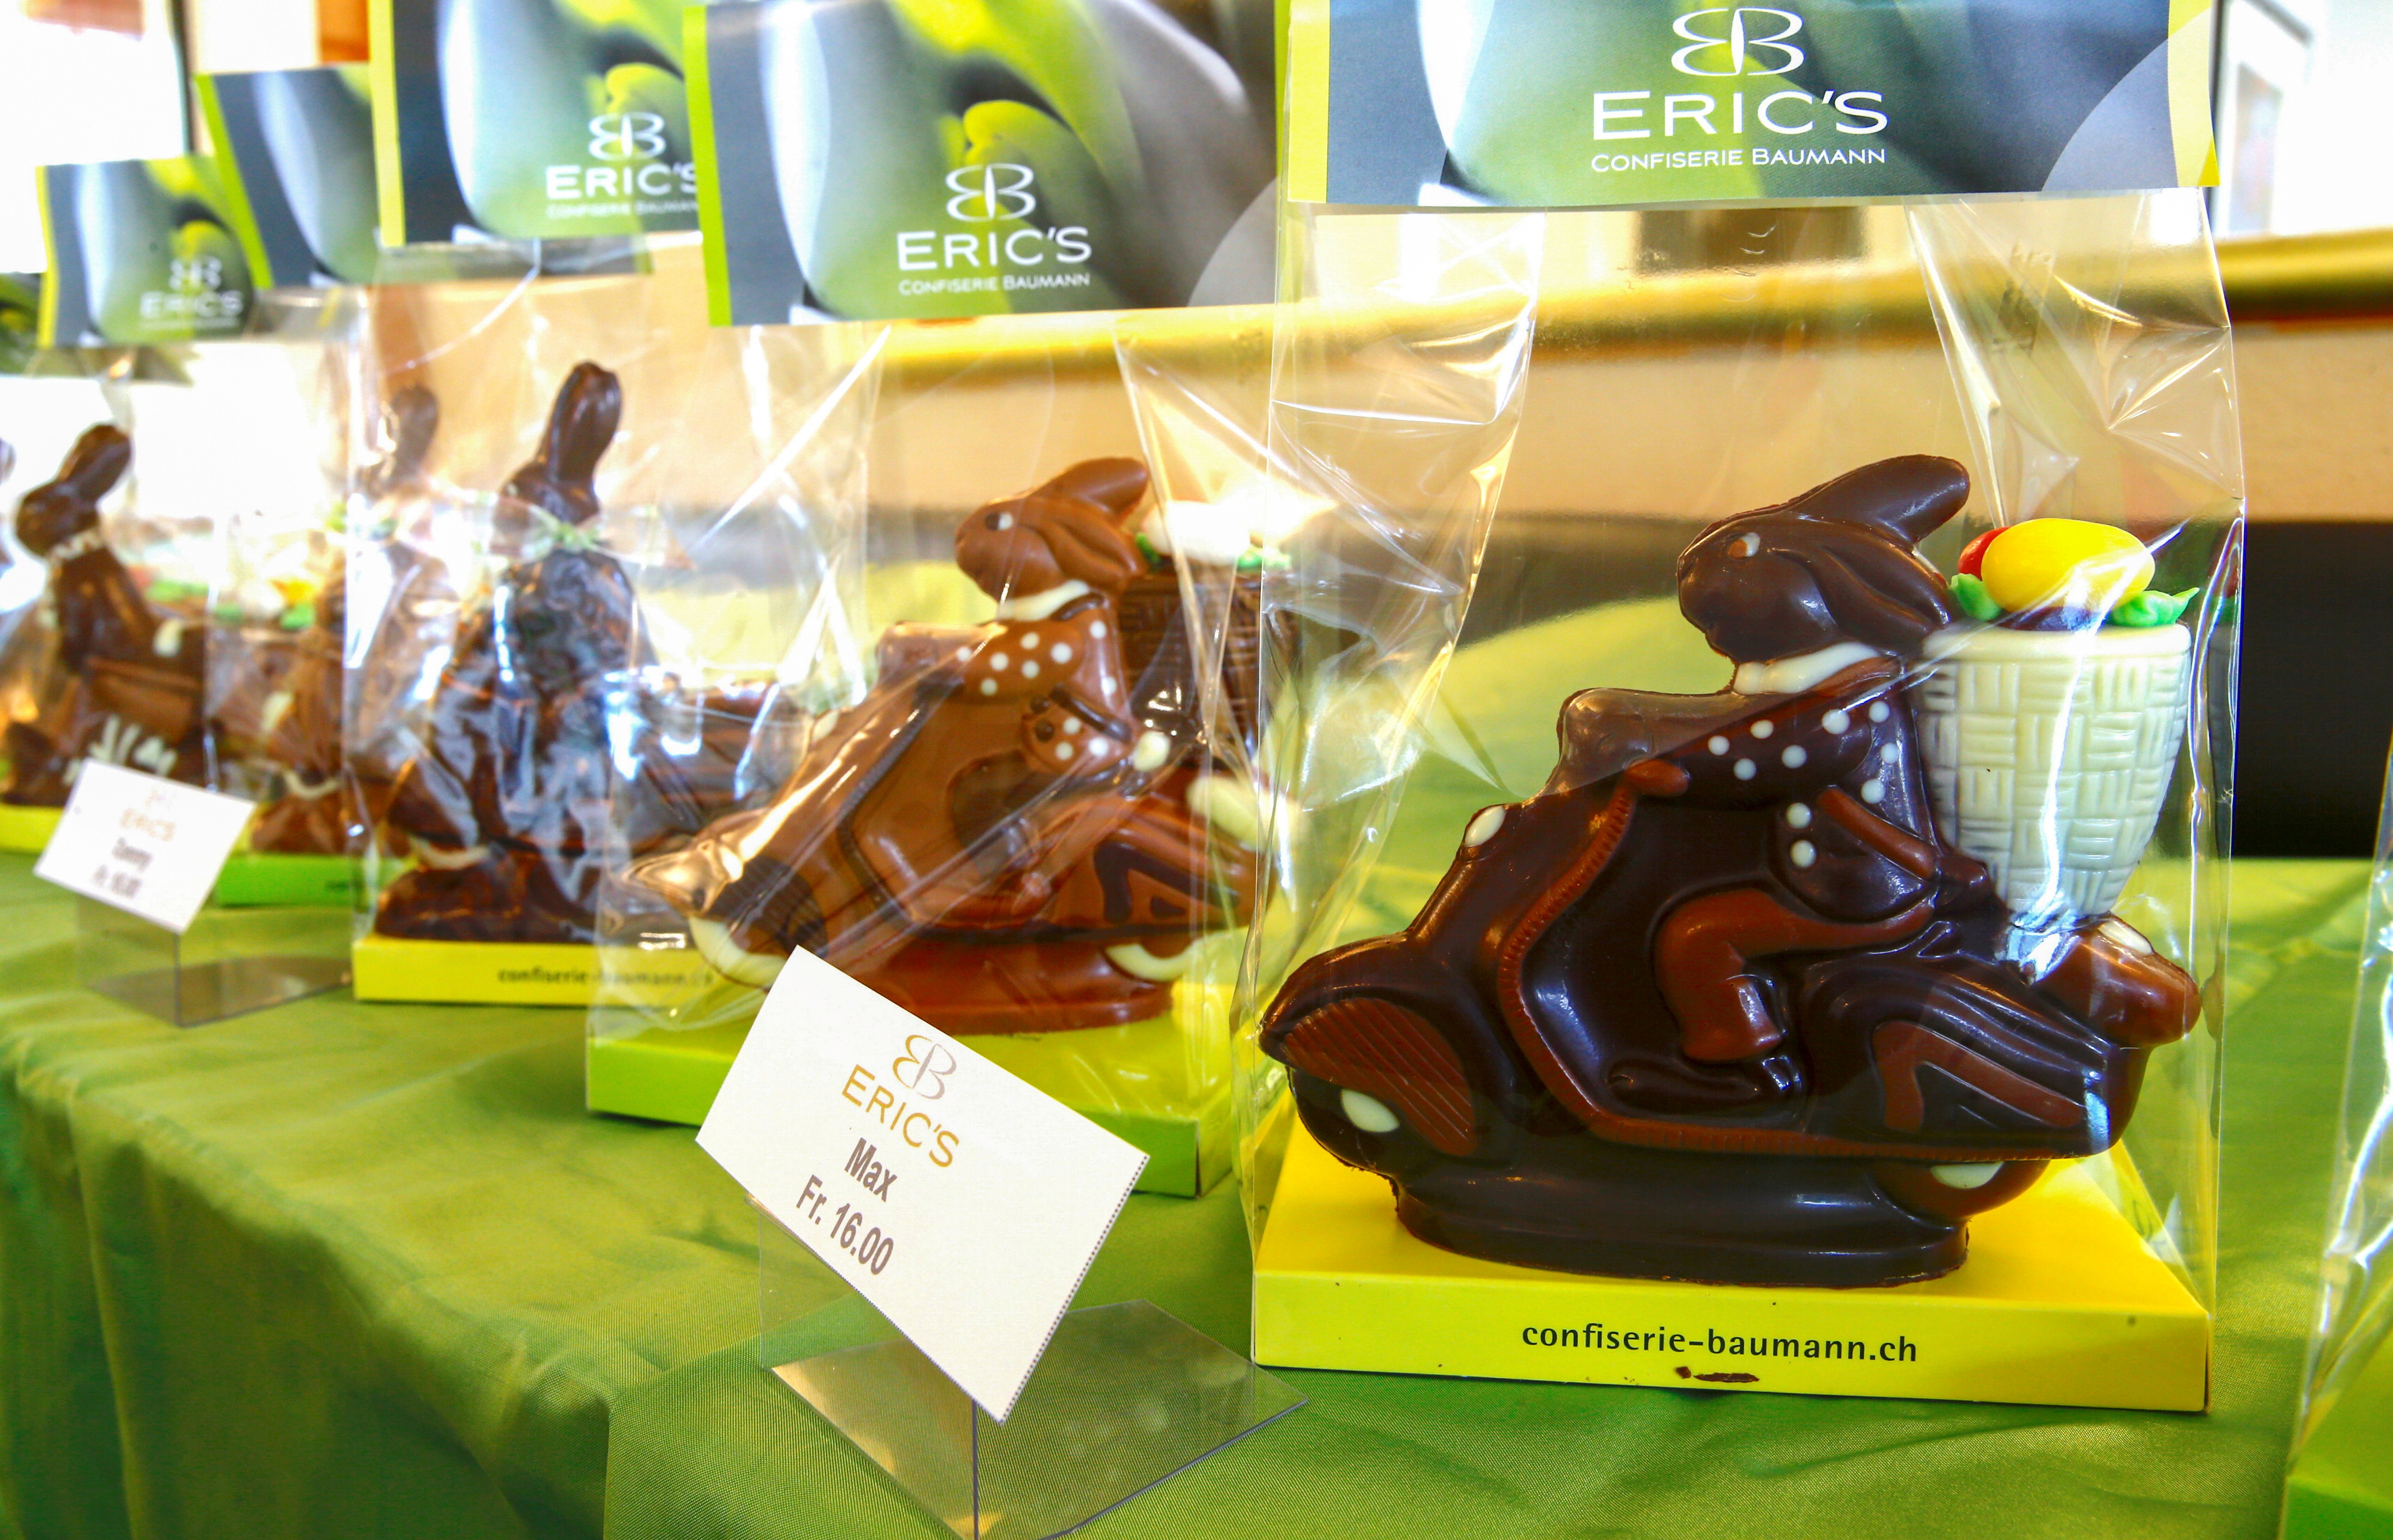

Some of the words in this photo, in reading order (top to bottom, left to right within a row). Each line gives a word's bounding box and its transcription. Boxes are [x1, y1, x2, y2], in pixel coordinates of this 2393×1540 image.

[1593, 89, 1889, 140] ERIC'S
[1591, 149, 1743, 172] CONFISERIE
[1752, 148, 1885, 166] BAUMANN
[896, 226, 1092, 271] ERIC'S
[898, 277, 998, 296] CONFISERIE
[1002, 273, 1091, 291] BAUMANN
[841, 1063, 960, 1168] ERIC'S
[844, 1137, 898, 1203] Max
[795, 1174, 827, 1225] Fr.
[830, 1203, 894, 1275] 16.00
[1522, 1323, 1917, 1362] confiserie-baumann.ch
